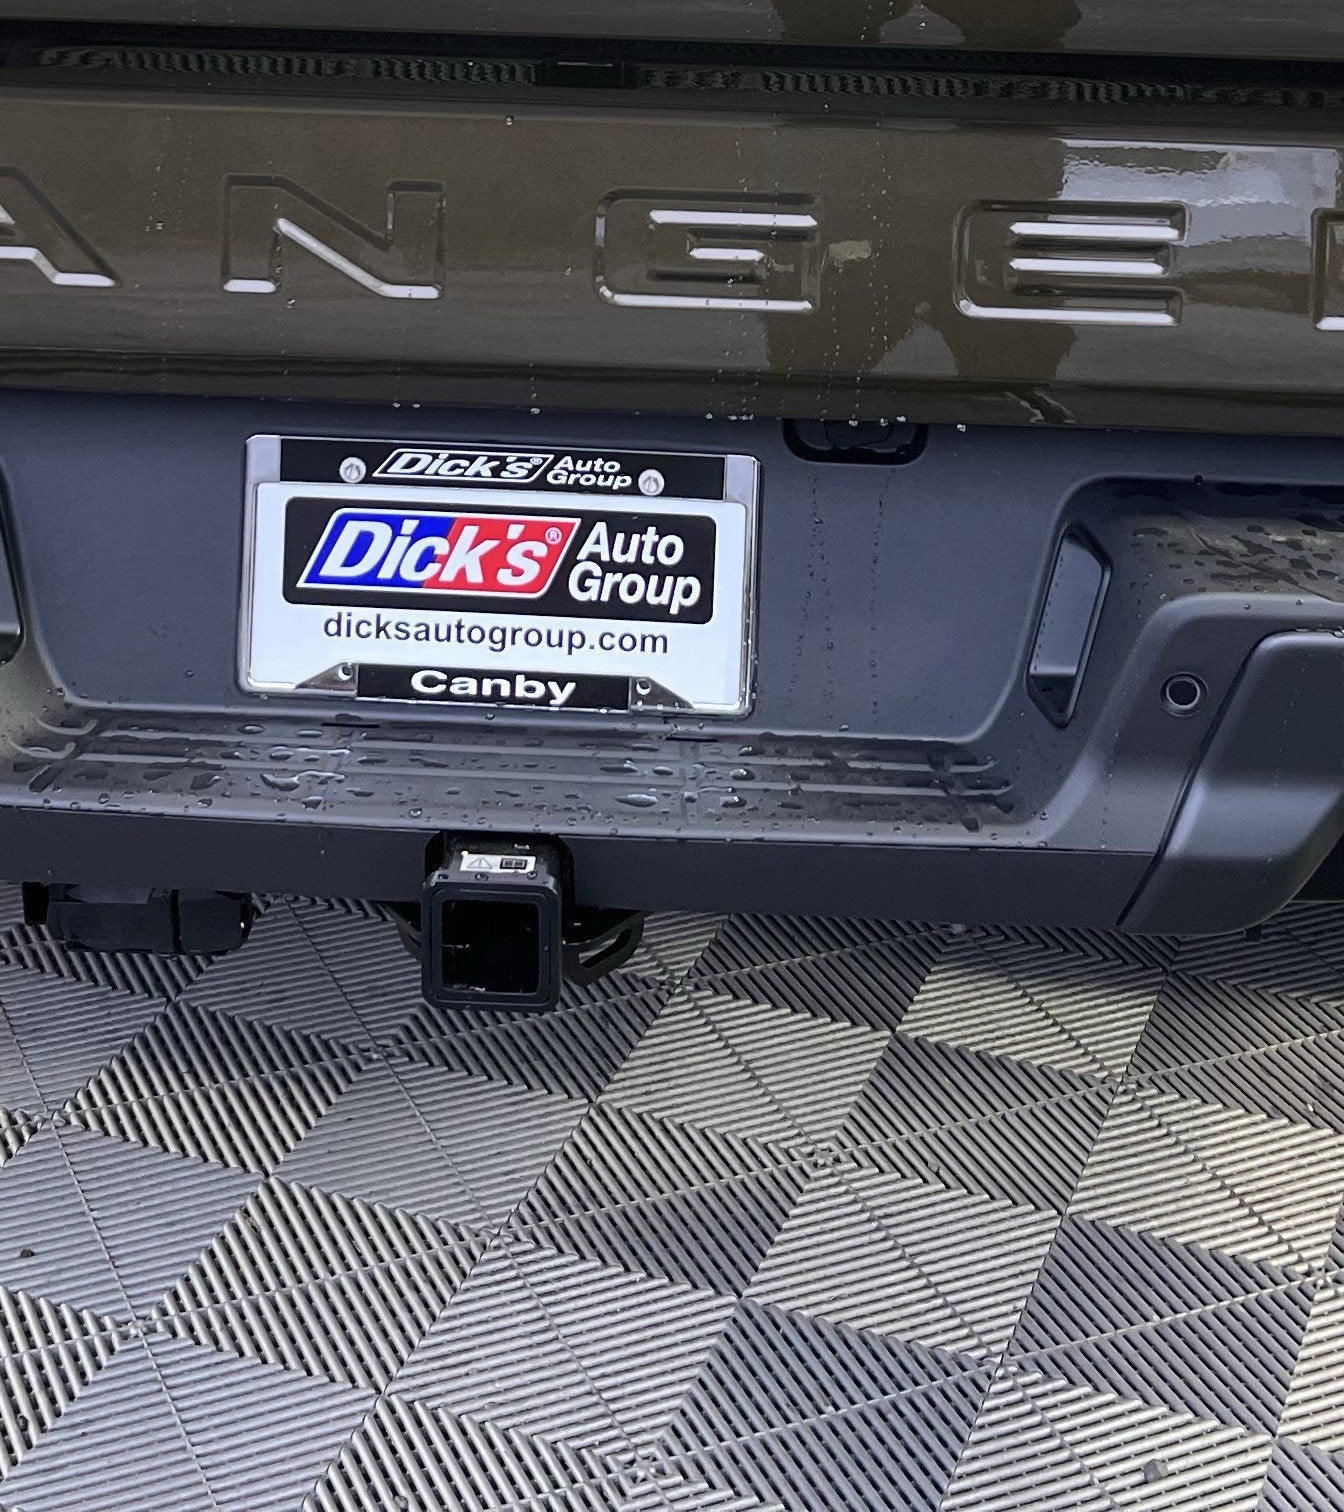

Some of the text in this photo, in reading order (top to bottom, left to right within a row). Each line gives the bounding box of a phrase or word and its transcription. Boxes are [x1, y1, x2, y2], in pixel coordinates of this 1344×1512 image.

[545, 470, 633, 490] Group
[555, 455, 621, 474] Auto
[575, 521, 685, 566] Auto
[567, 562, 702, 615] Group
[322, 611, 670, 656] dicksautogroup.com
[410, 669, 577, 708] Canby
